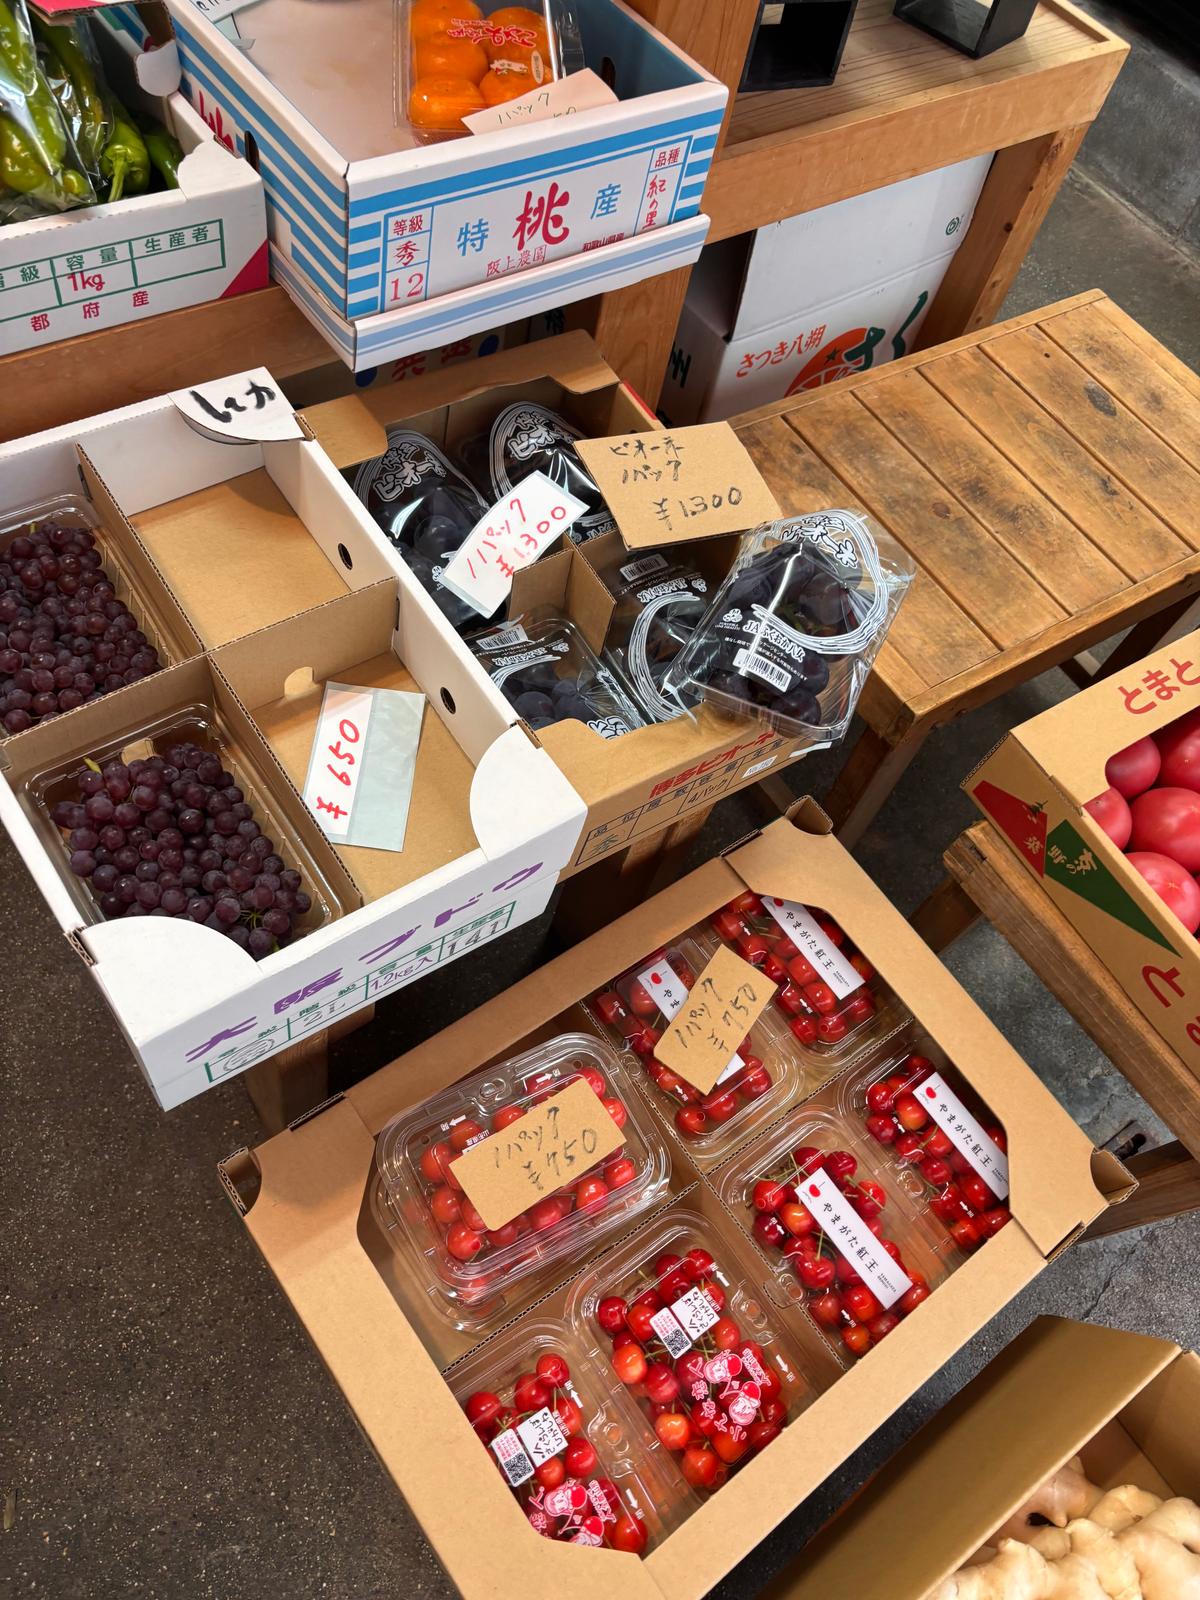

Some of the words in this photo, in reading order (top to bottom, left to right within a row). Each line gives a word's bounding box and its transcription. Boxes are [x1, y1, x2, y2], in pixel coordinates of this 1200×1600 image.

[654, 147, 681, 168] 品種
[393, 215, 424, 236] 等級
[457, 219, 489, 257] 特
[512, 182, 570, 251] 桃
[590, 184, 622, 220] 産
[66, 247, 118, 272] 容量
[144, 226, 210, 253] 生産者
[395, 240, 420, 266] 秀
[67, 271, 105, 292] 1kg
[391, 272, 424, 301] 12
[736, 323, 827, 379] さつき八朔
[1118, 658, 1200, 714] とまと
[185, 862, 544, 1063] 大阪ブドウ
[785, 911, 835, 971] やまがた紅王
[938, 1102, 994, 1168] やまがた紅王
[823, 1202, 880, 1273] やまがた紅王
[690, 1288, 715, 1322] ひがしね
[528, 1415, 557, 1455] さくらんぼ
[538, 1411, 564, 1447] ひがしね
